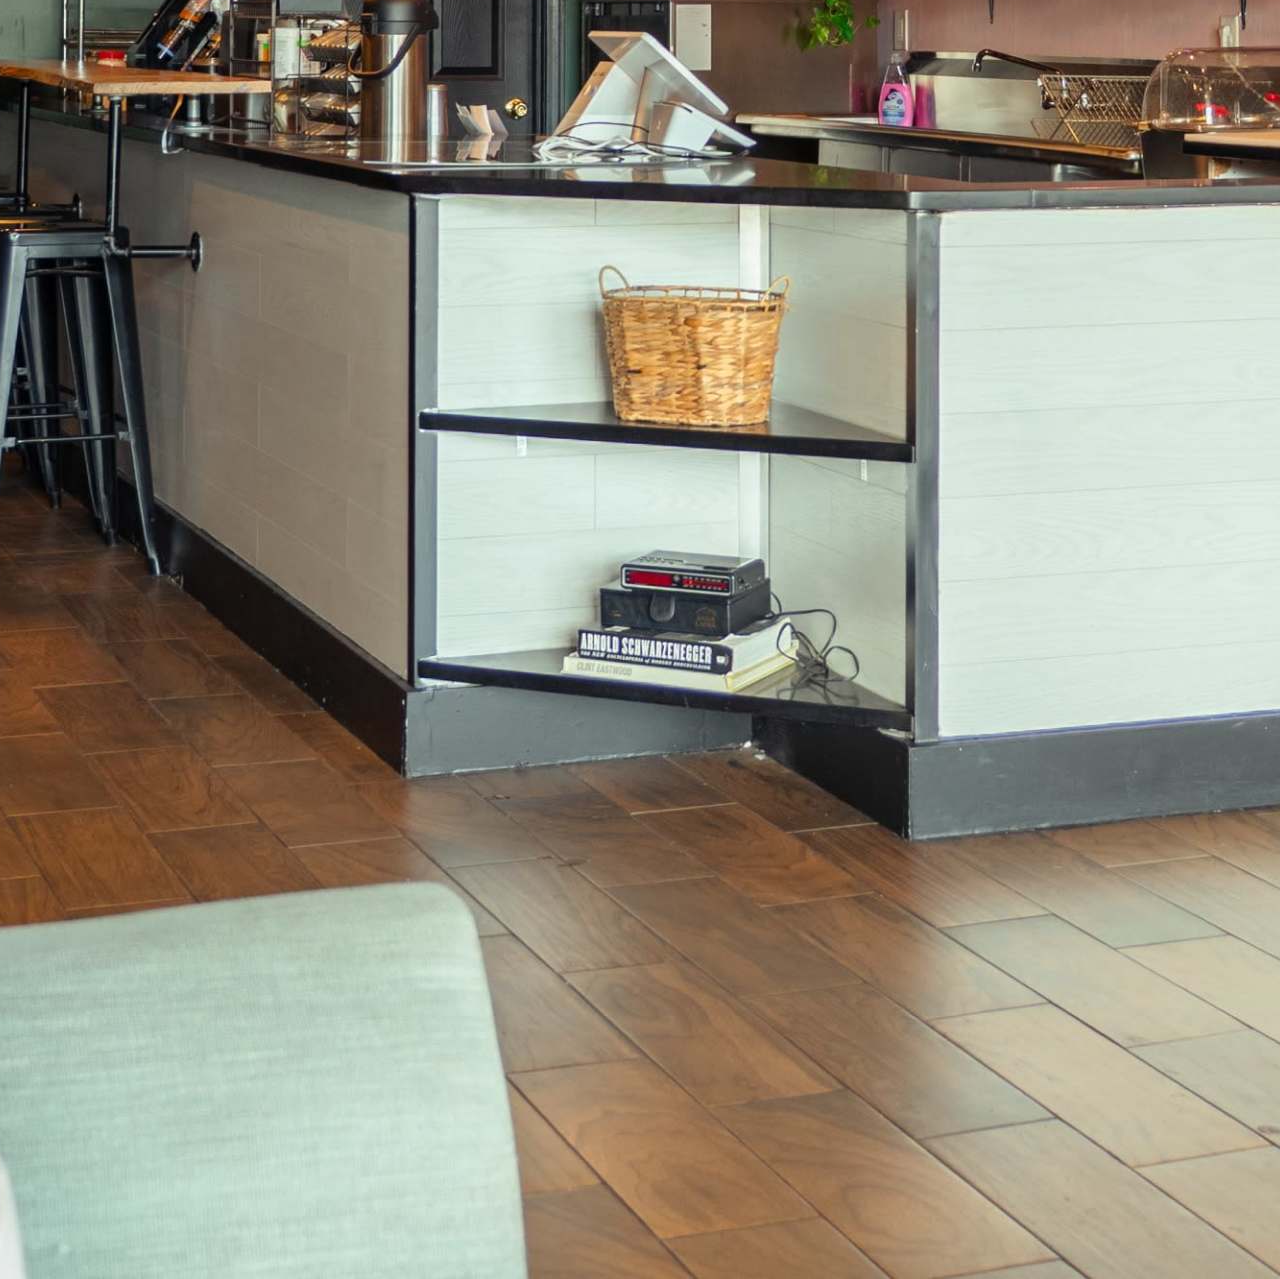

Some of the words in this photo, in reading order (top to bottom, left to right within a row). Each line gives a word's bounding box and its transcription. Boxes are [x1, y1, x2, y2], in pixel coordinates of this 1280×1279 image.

[580, 632, 620, 654] ARNOLD
[621, 636, 713, 665] SCHWARZENEGGER
[576, 660, 596, 672] CLINT
[596, 662, 633, 676] EASTWOOD
